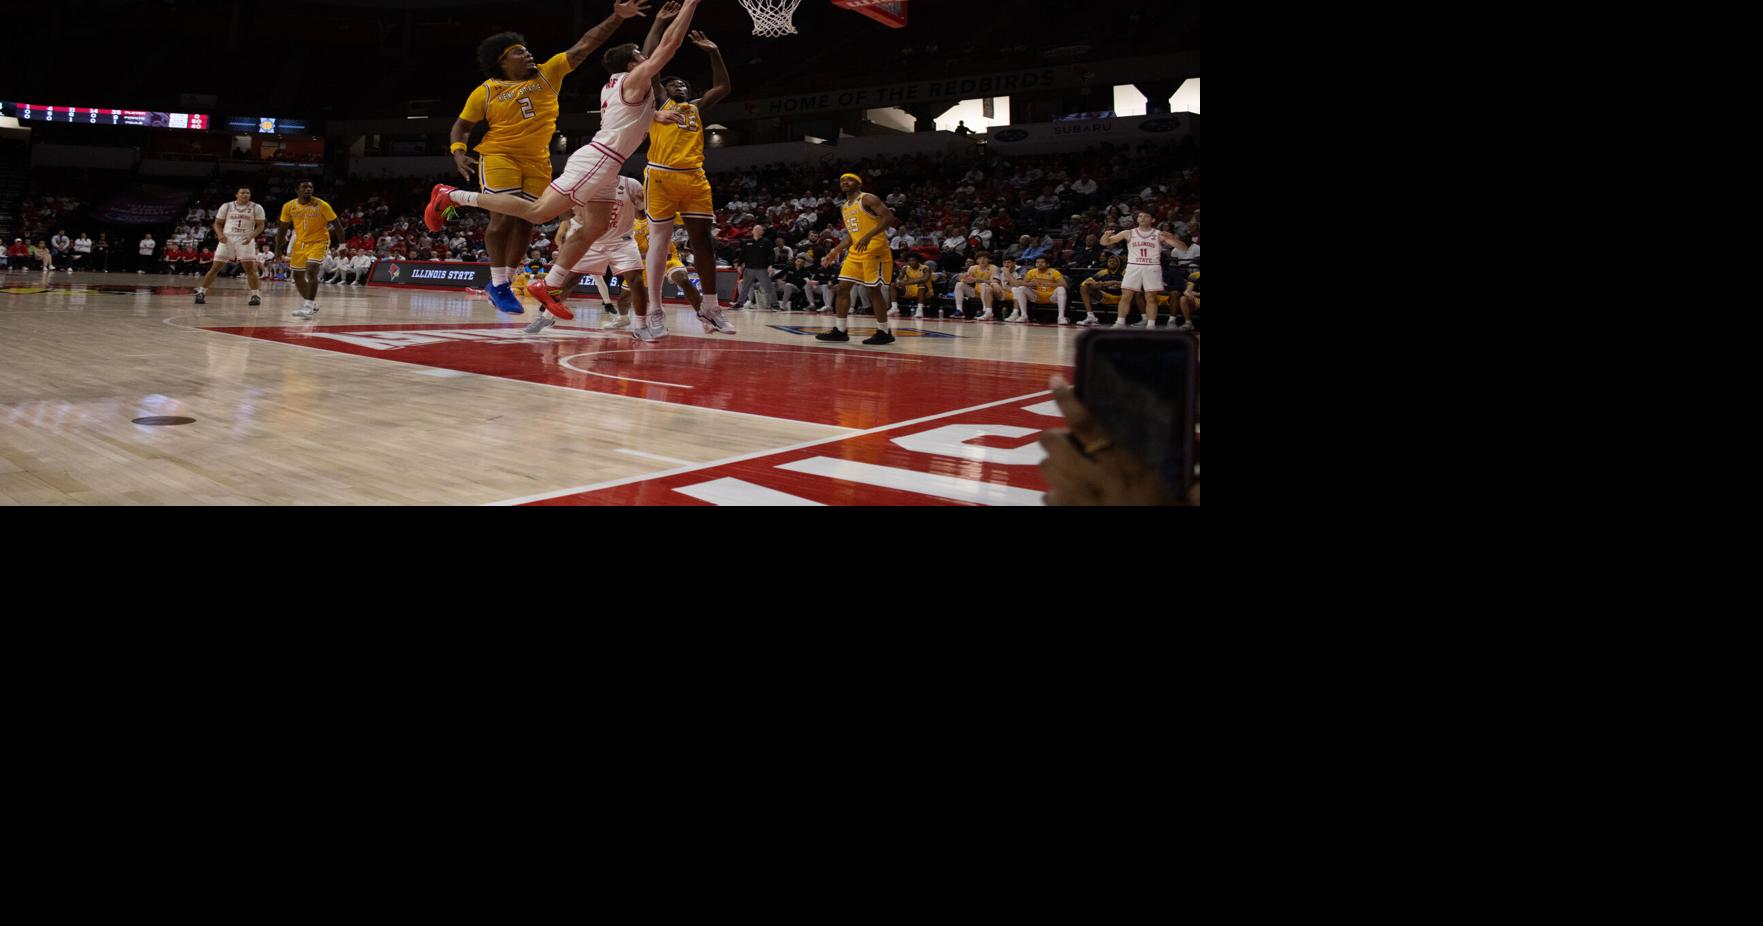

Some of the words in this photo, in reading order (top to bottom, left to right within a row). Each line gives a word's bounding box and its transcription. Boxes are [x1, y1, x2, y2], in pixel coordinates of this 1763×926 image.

[769, 96, 829, 114] HOME
[838, 91, 865, 107] OF
[878, 85, 917, 102] THE
[930, 70, 1054, 98] REDBIRDS
[517, 97, 536, 119] 2
[1055, 124, 1111, 135] SUBARU
[237, 220, 242, 228] 1
[1140, 248, 1148, 258] 11
[411, 269, 447, 279] ILLINOIS
[447, 270, 476, 281] STATE
